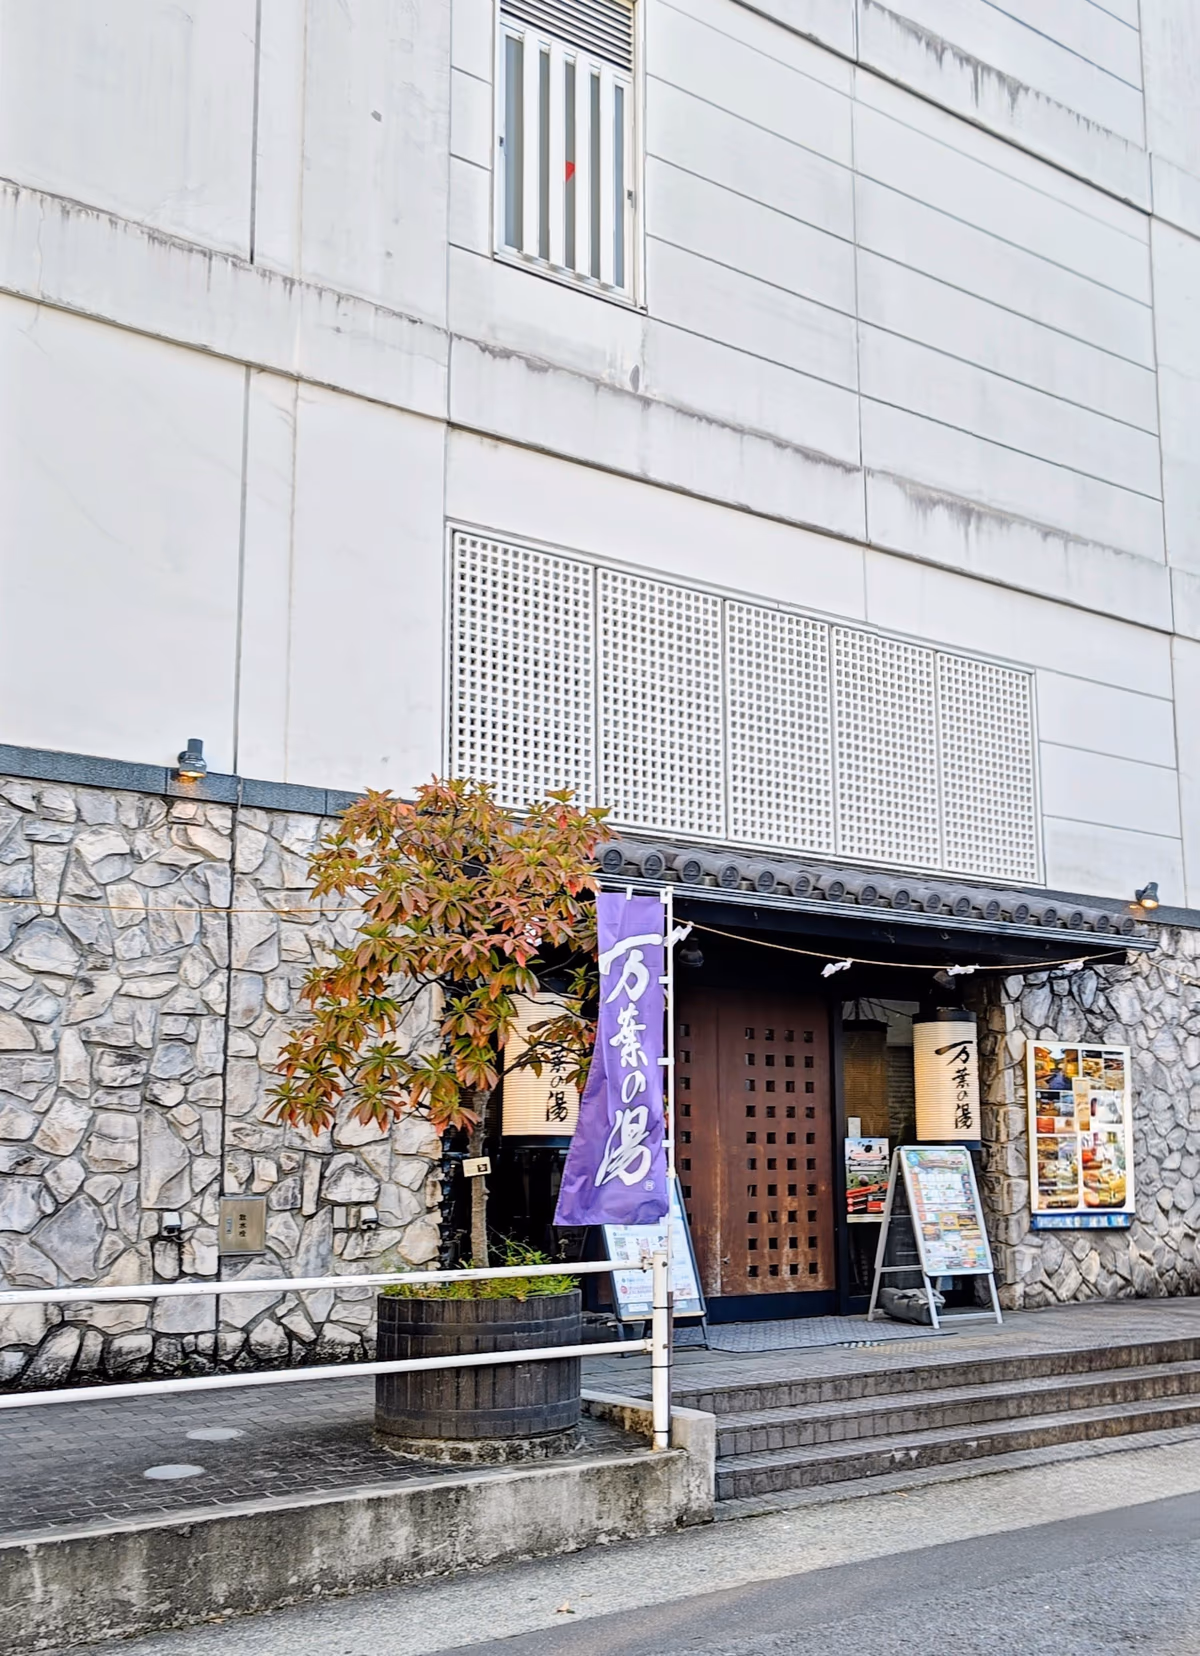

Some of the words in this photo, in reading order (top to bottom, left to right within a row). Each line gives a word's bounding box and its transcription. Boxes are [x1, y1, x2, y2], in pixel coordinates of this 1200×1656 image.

[595, 933, 663, 1187] 万葉の湯
[935, 1040, 974, 1129] 万葉の湯
